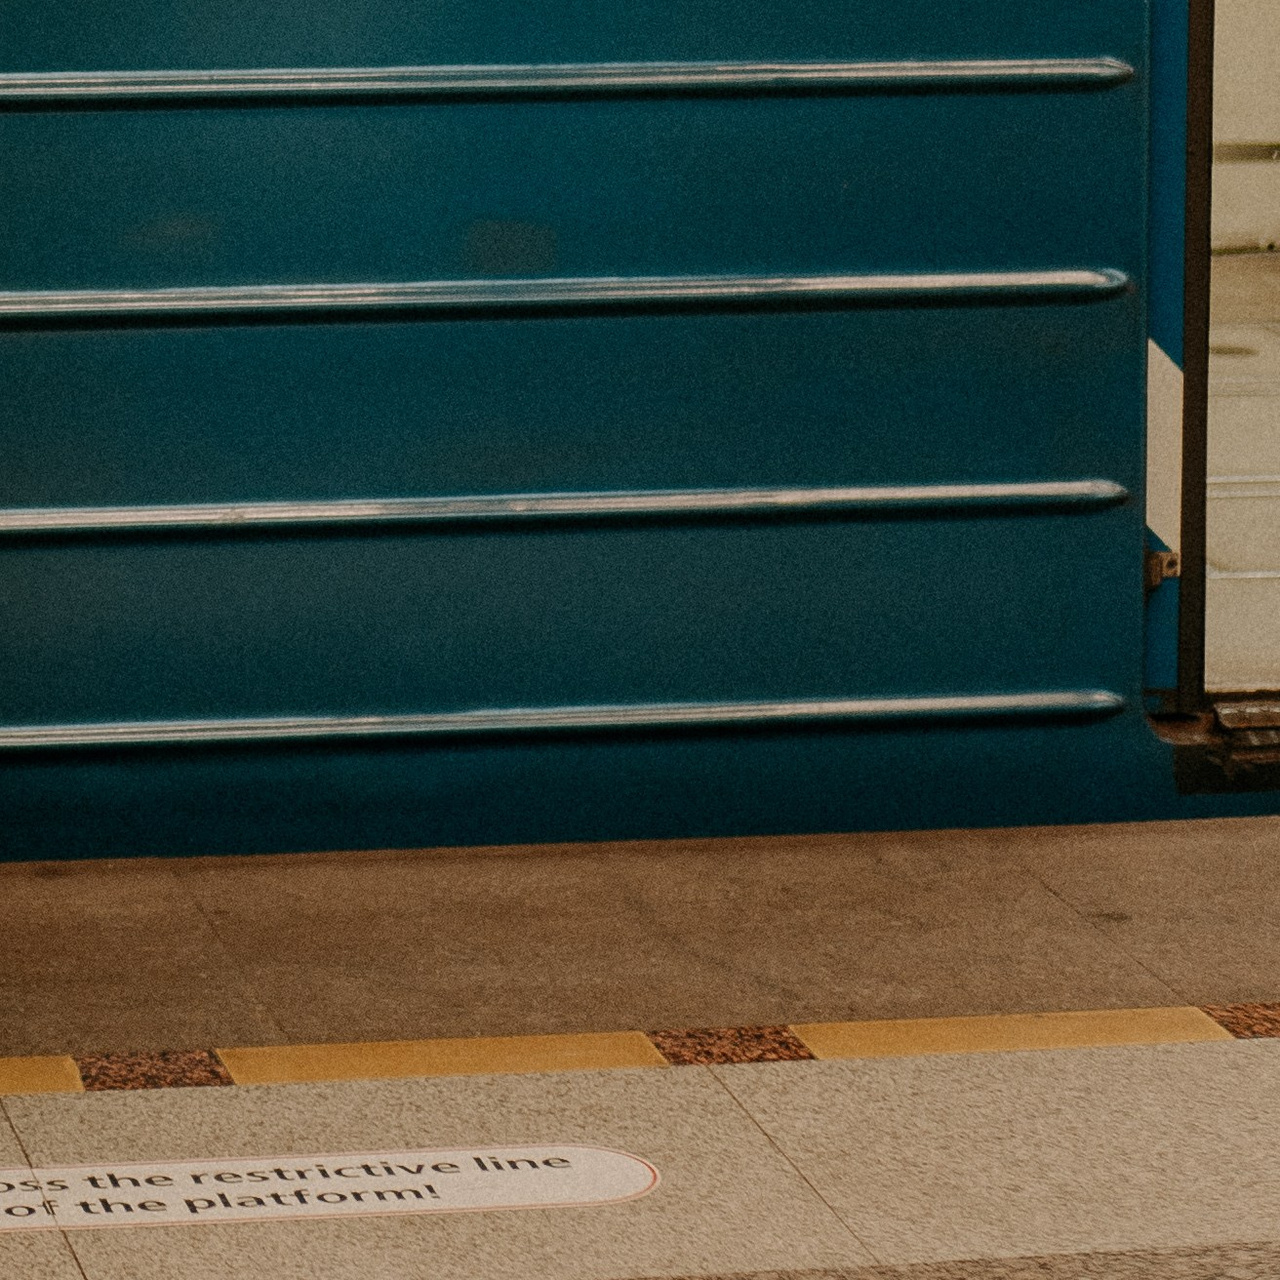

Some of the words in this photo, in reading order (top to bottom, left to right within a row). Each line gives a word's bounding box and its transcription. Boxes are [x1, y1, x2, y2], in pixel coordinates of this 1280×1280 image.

[82, 1172, 174, 1190] the
[190, 1160, 462, 1186] restrictive
[473, 1153, 571, 1172] line
[4, 1199, 60, 1218] of
[75, 1197, 167, 1215] the
[183, 1183, 440, 1215] platform!
